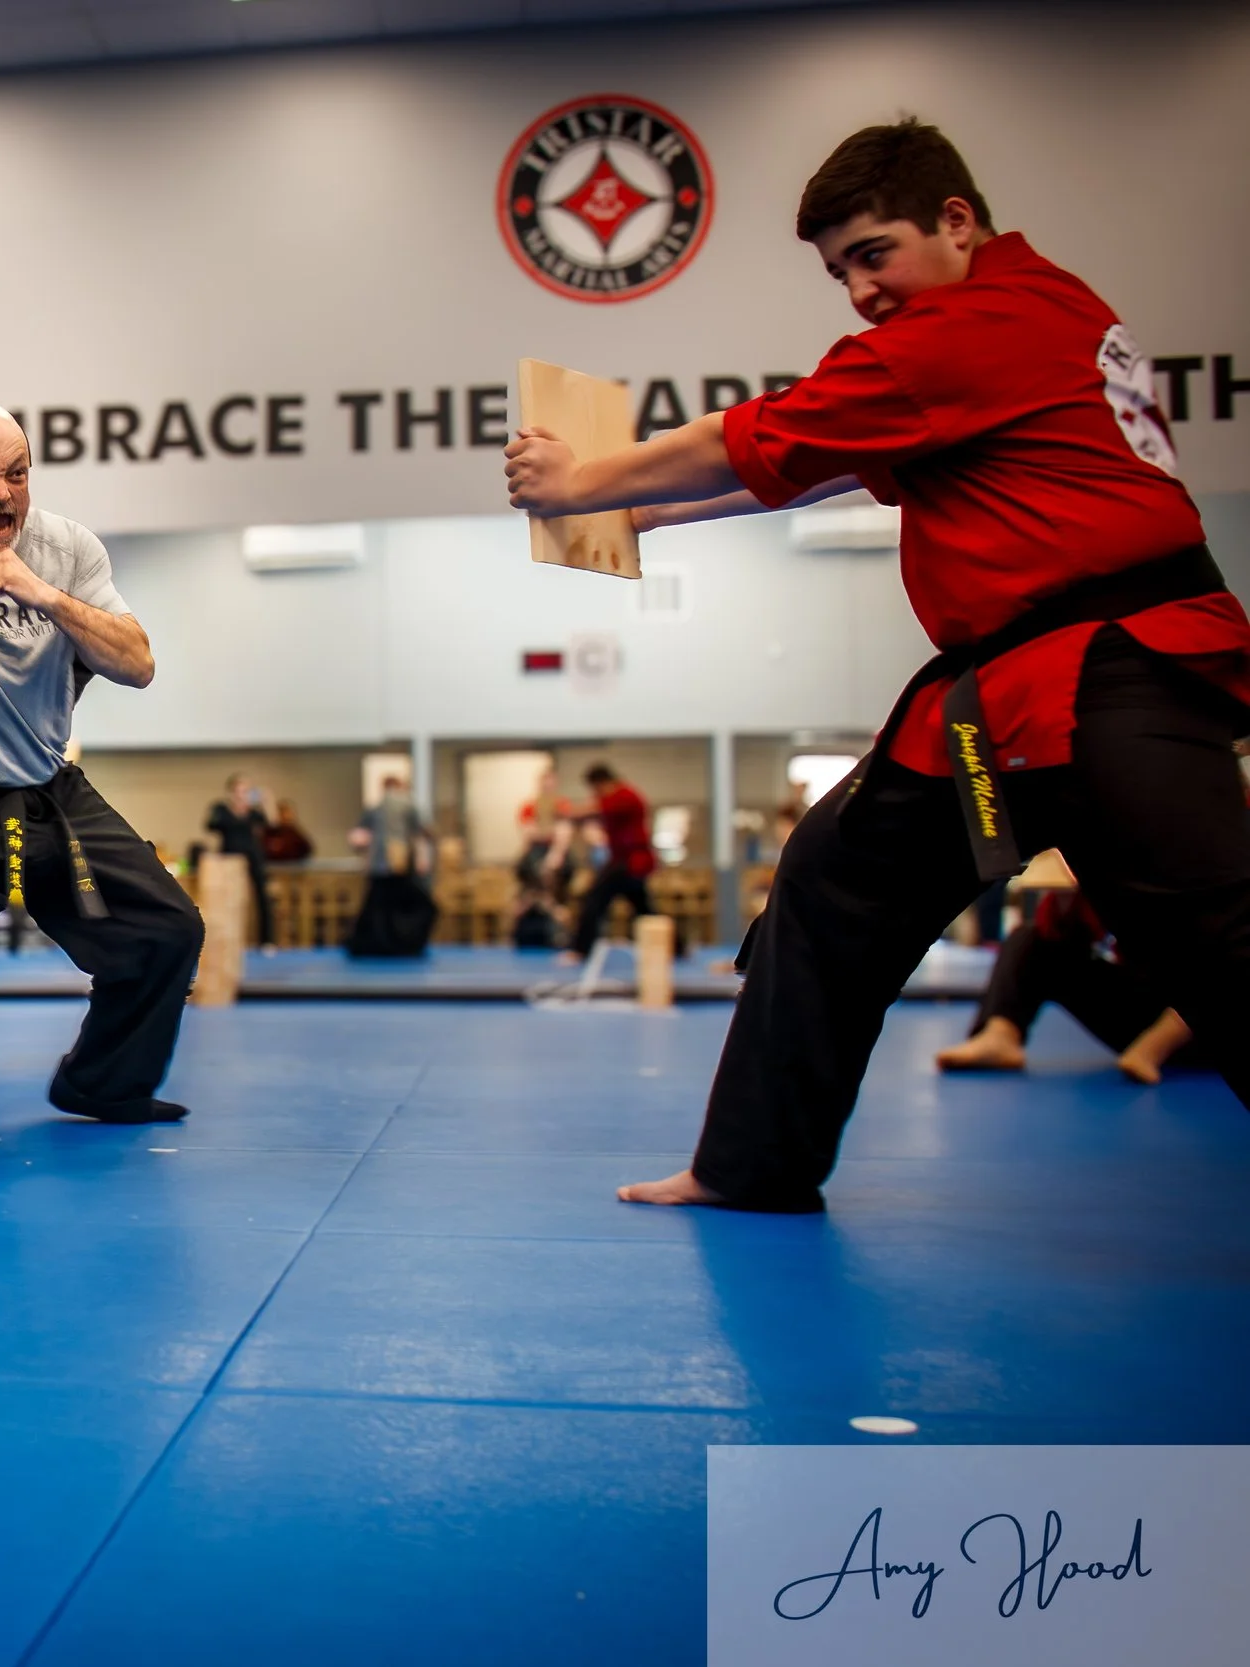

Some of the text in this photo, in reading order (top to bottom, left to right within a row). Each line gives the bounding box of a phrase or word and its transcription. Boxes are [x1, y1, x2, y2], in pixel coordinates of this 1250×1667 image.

[338, 385, 508, 454] THE
[950, 723, 998, 838] Joseph Malone
